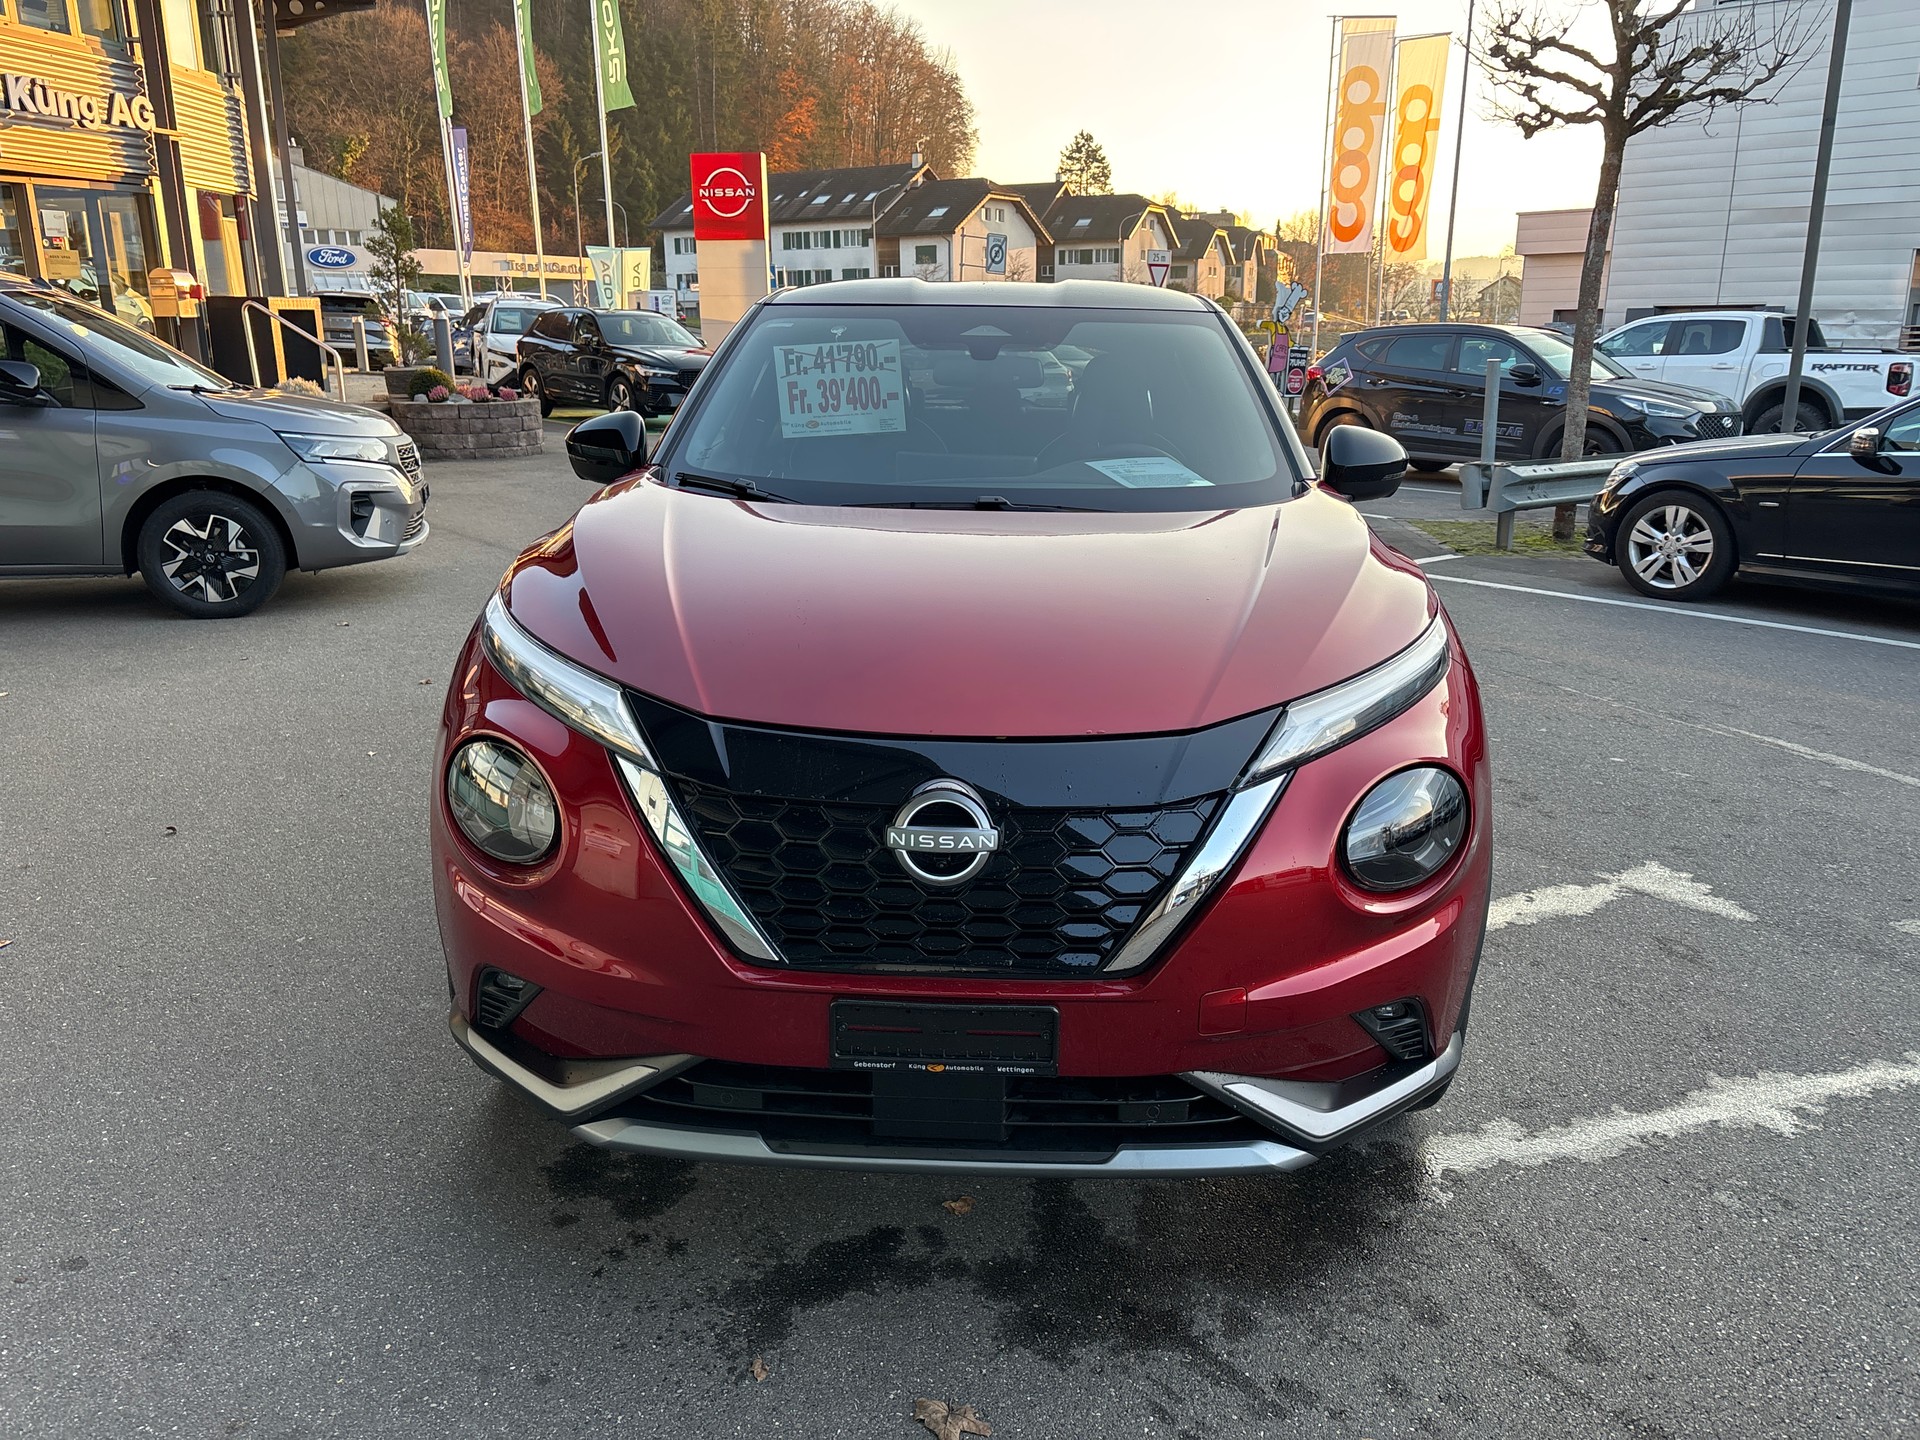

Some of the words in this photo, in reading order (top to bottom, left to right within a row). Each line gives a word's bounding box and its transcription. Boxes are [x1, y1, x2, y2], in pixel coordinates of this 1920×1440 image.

[5, 73, 102, 130] Küng
[110, 92, 156, 131] AG
[1329, 65, 1386, 242] coop
[1389, 84, 1441, 252] coop
[457, 147, 468, 194] Center
[699, 187, 755, 197] NISSAN
[461, 195, 471, 243] Transit
[318, 249, 348, 265] Ford
[1152, 254, 1160, 262] 25
[1811, 364, 1882, 375] RAPTOR
[787, 381, 813, 414] Fr.
[890, 832, 995, 849] NISSAN
